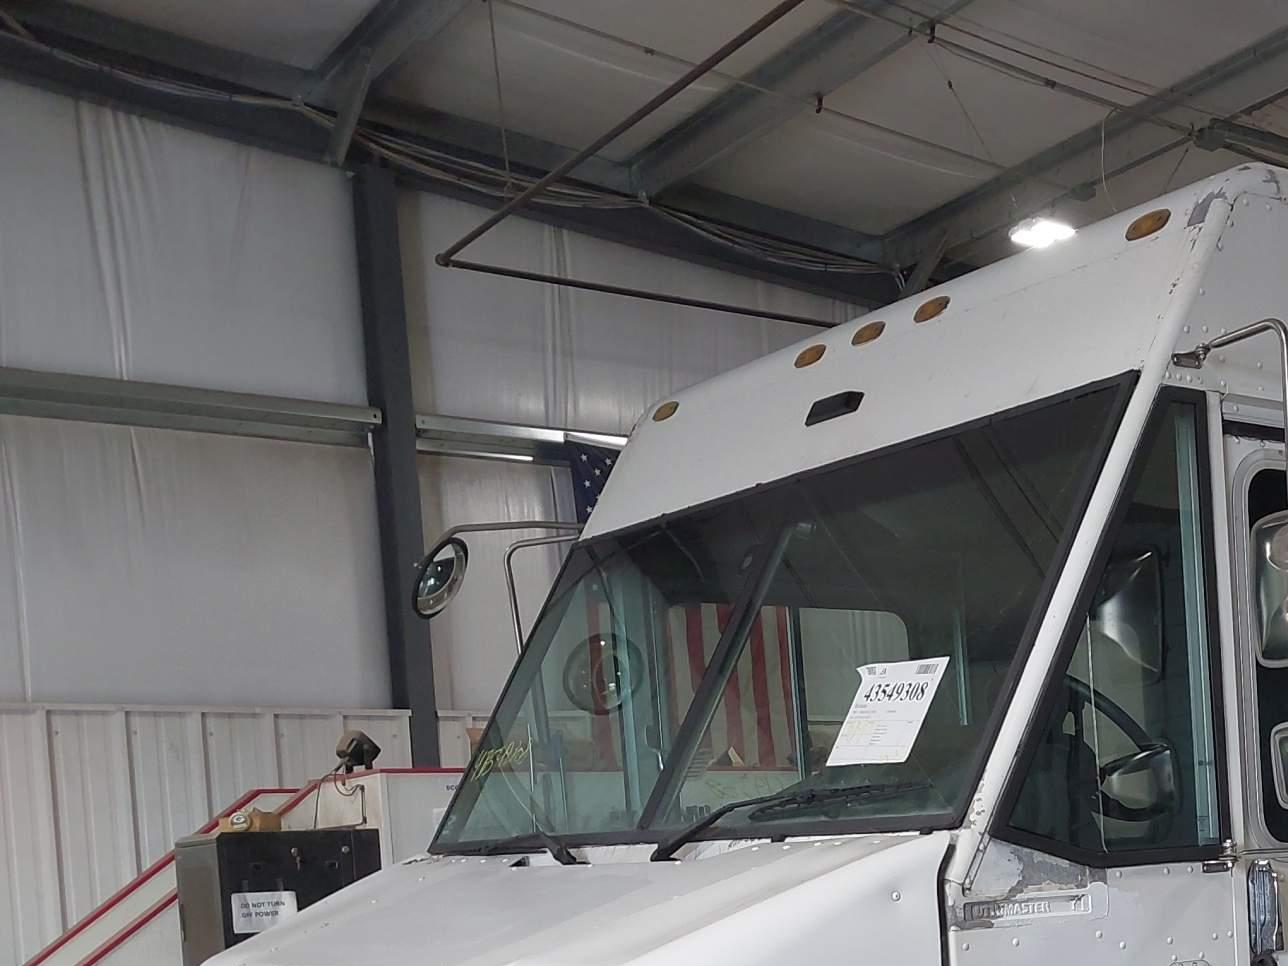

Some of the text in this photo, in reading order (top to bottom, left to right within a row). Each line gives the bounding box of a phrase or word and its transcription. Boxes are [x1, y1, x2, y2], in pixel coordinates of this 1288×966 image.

[863, 681, 929, 702] 43549308
[251, 901, 266, 909] NOT
[267, 900, 286, 908] TURN
[254, 910, 279, 918] POWER
